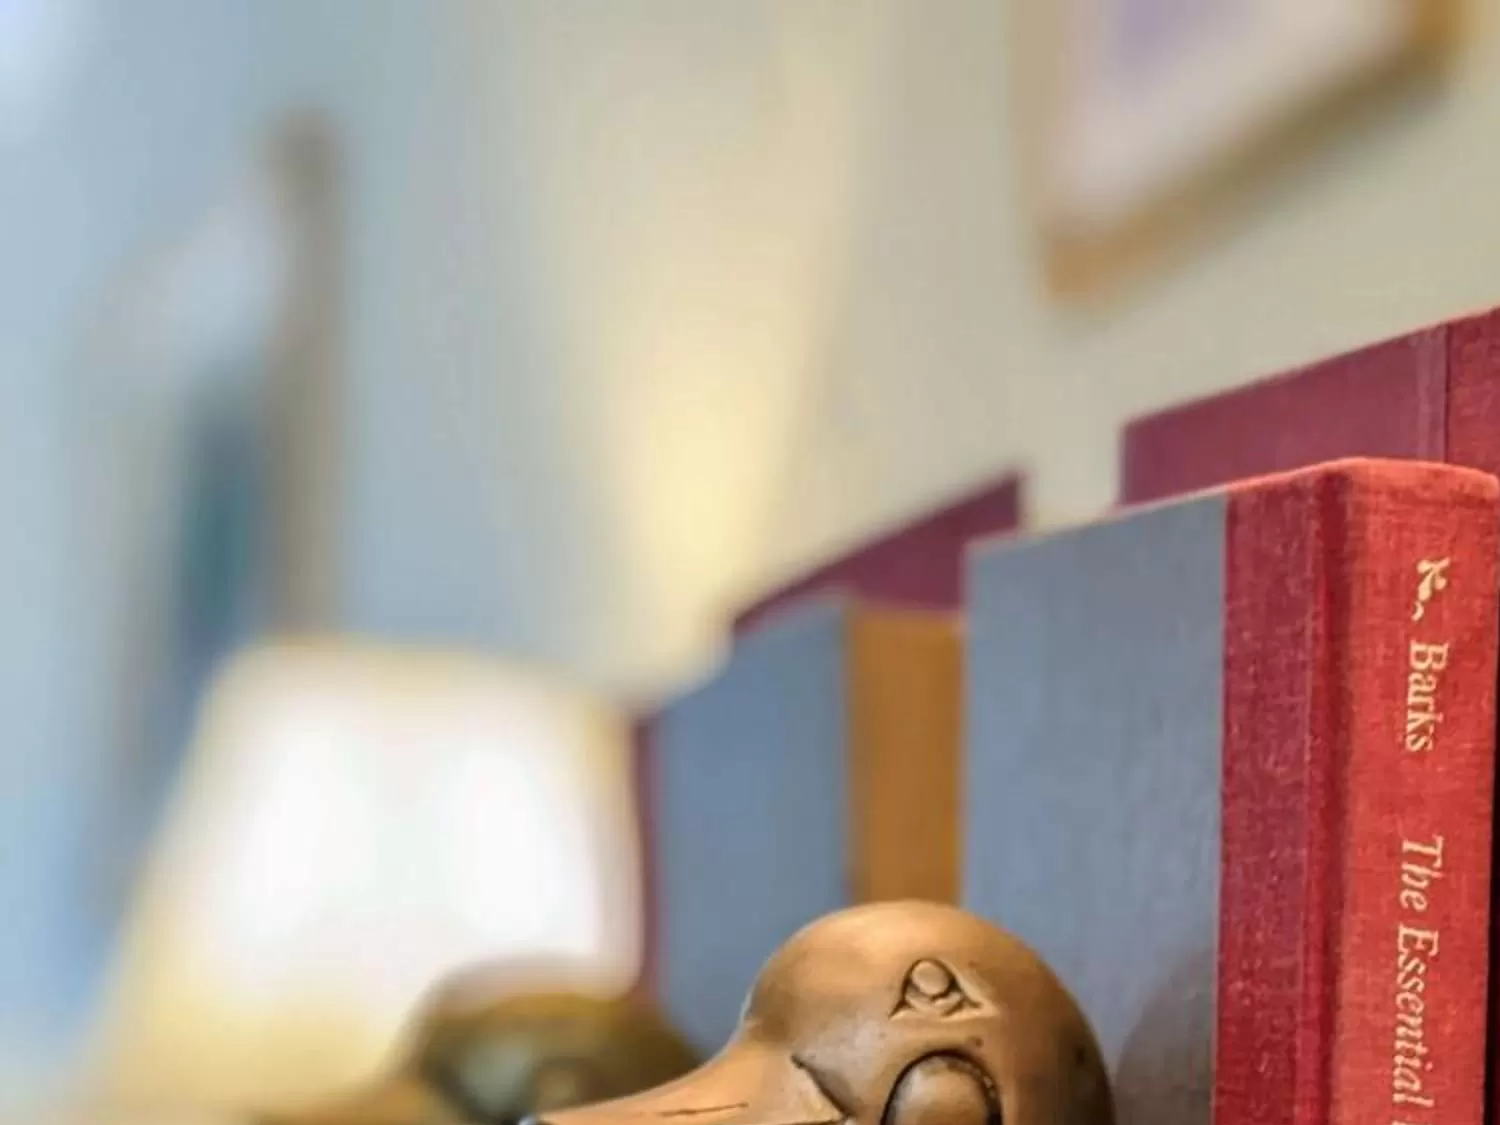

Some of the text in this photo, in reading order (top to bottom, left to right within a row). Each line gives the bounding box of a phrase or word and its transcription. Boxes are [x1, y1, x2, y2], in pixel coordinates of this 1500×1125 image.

[1406, 640, 1449, 753] Barks
[1398, 835, 1445, 912] The
[1391, 923, 1439, 1108] Essential
